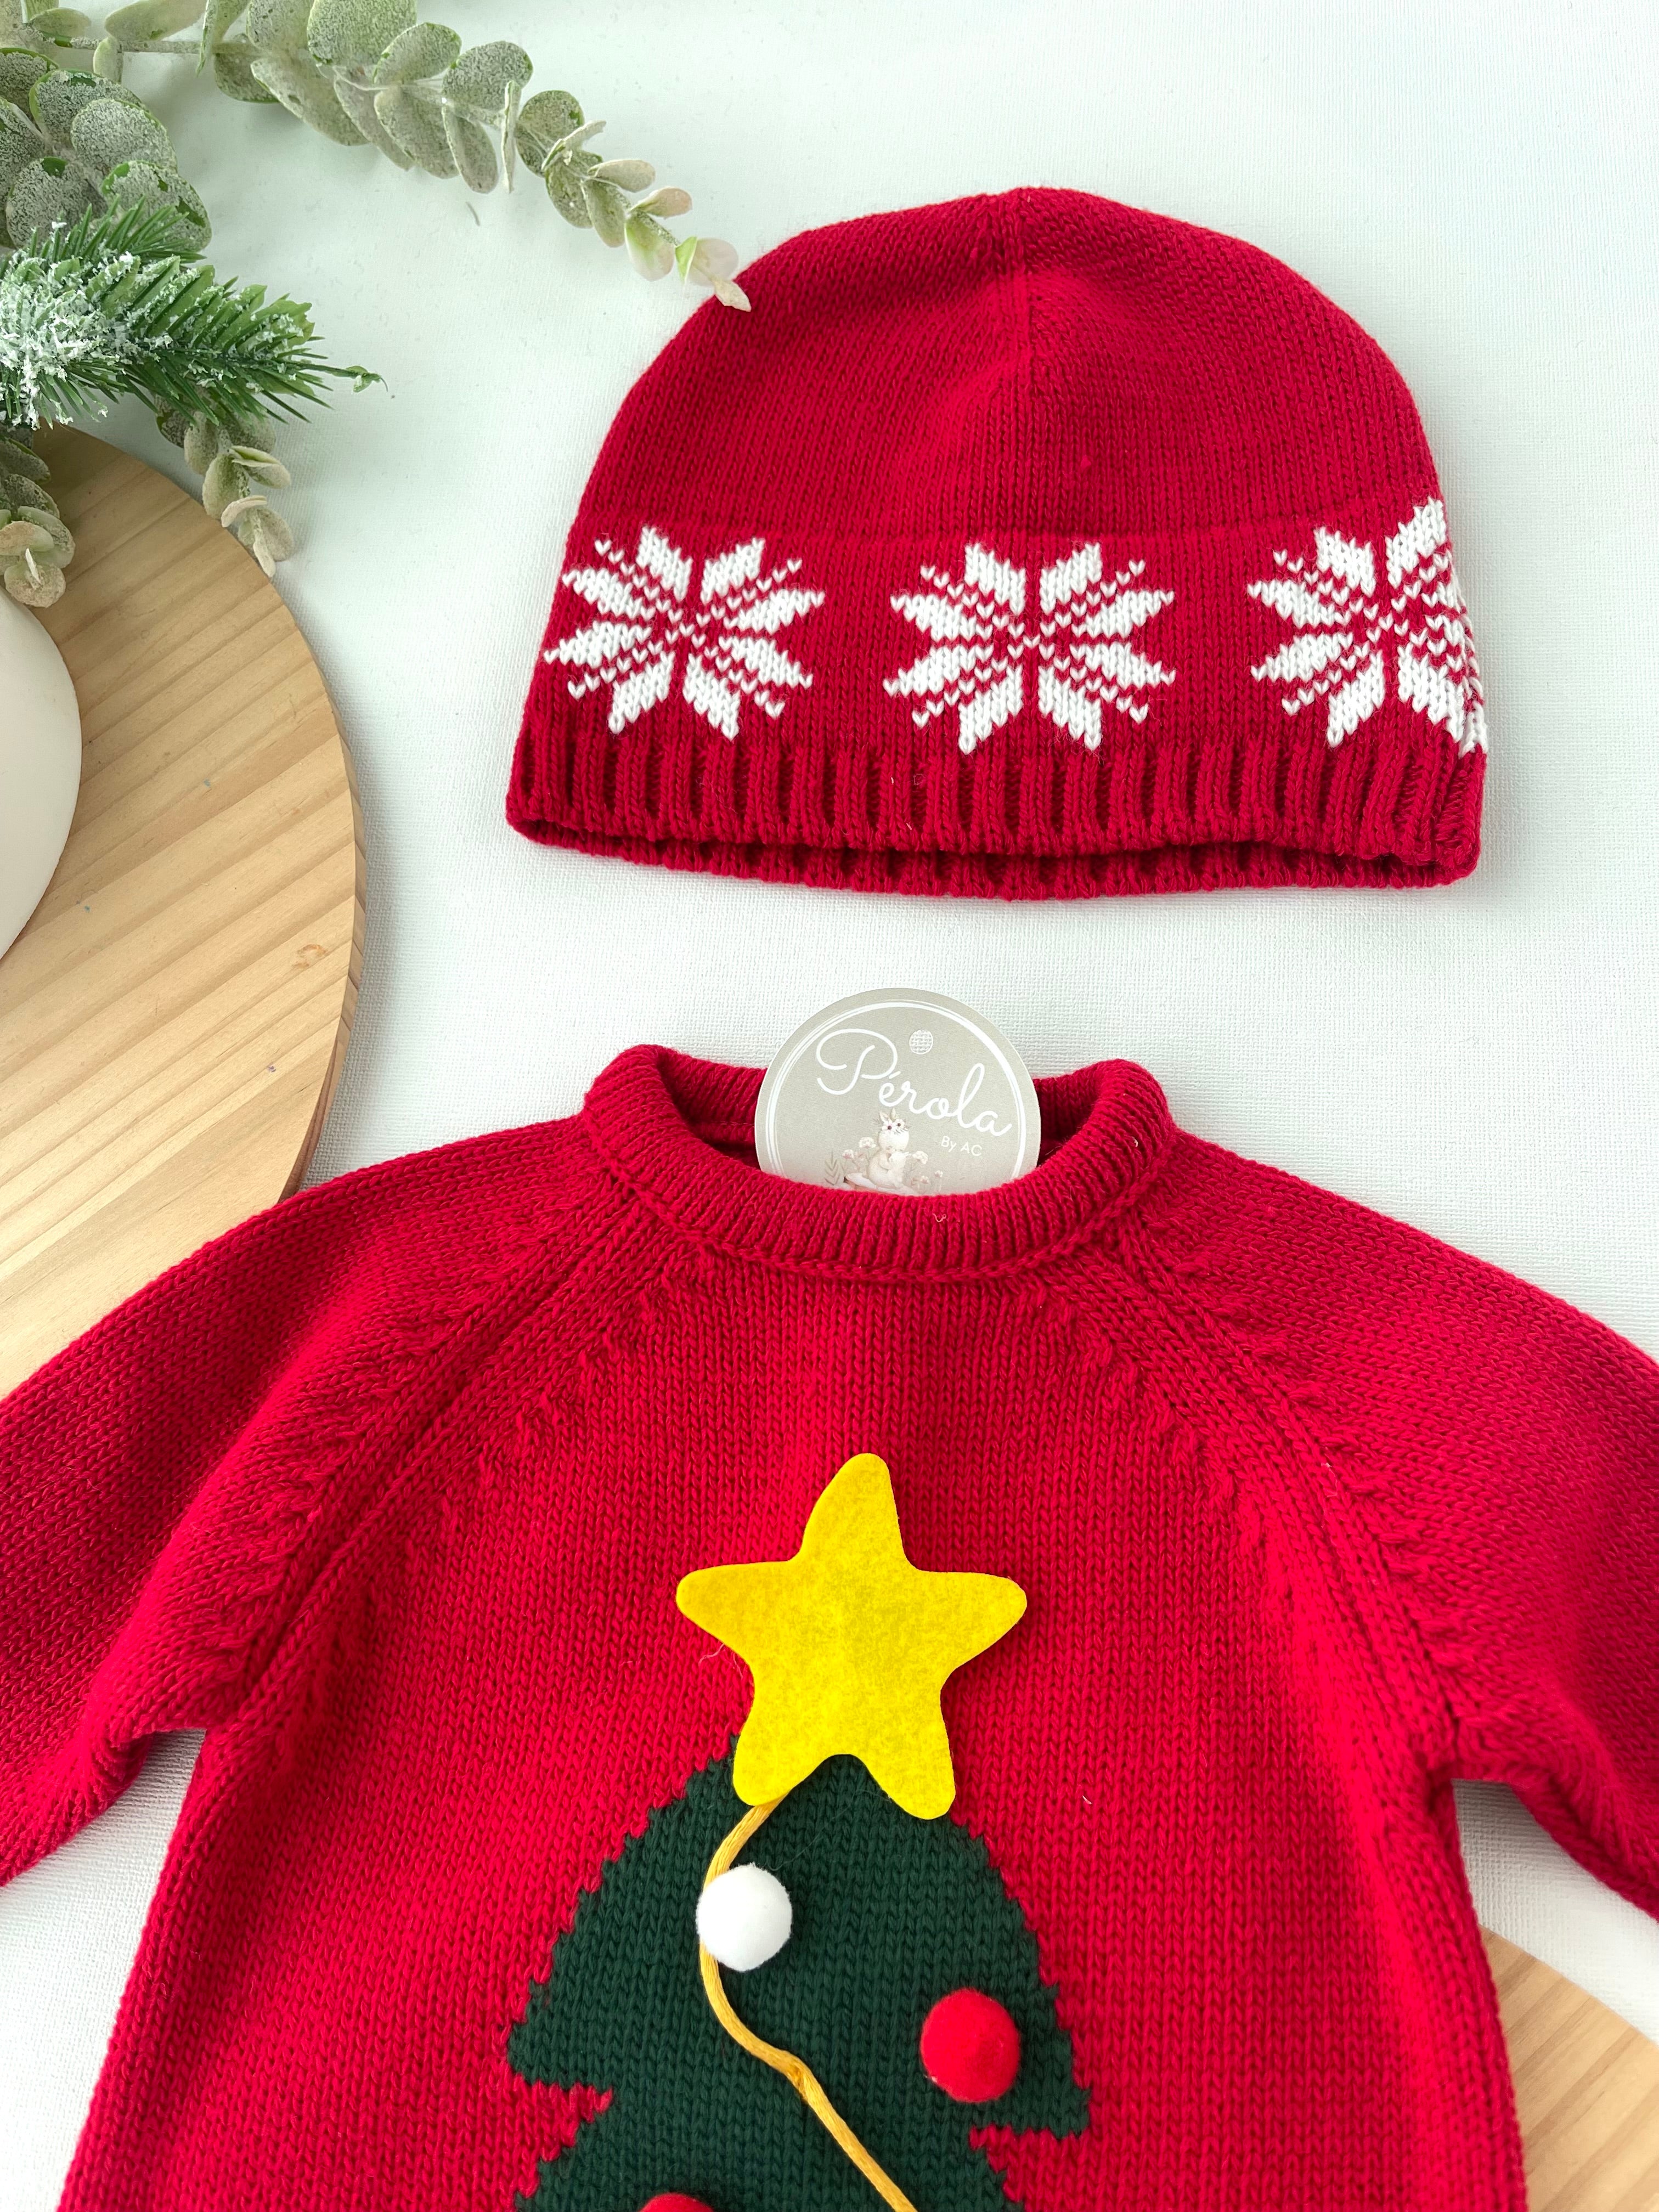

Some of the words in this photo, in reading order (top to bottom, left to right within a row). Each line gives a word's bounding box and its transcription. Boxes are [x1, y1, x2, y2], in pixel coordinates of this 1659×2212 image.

[816, 1028, 1012, 1136] Pérola
[941, 1136, 956, 1152] By
[961, 1142, 982, 1156] AC
